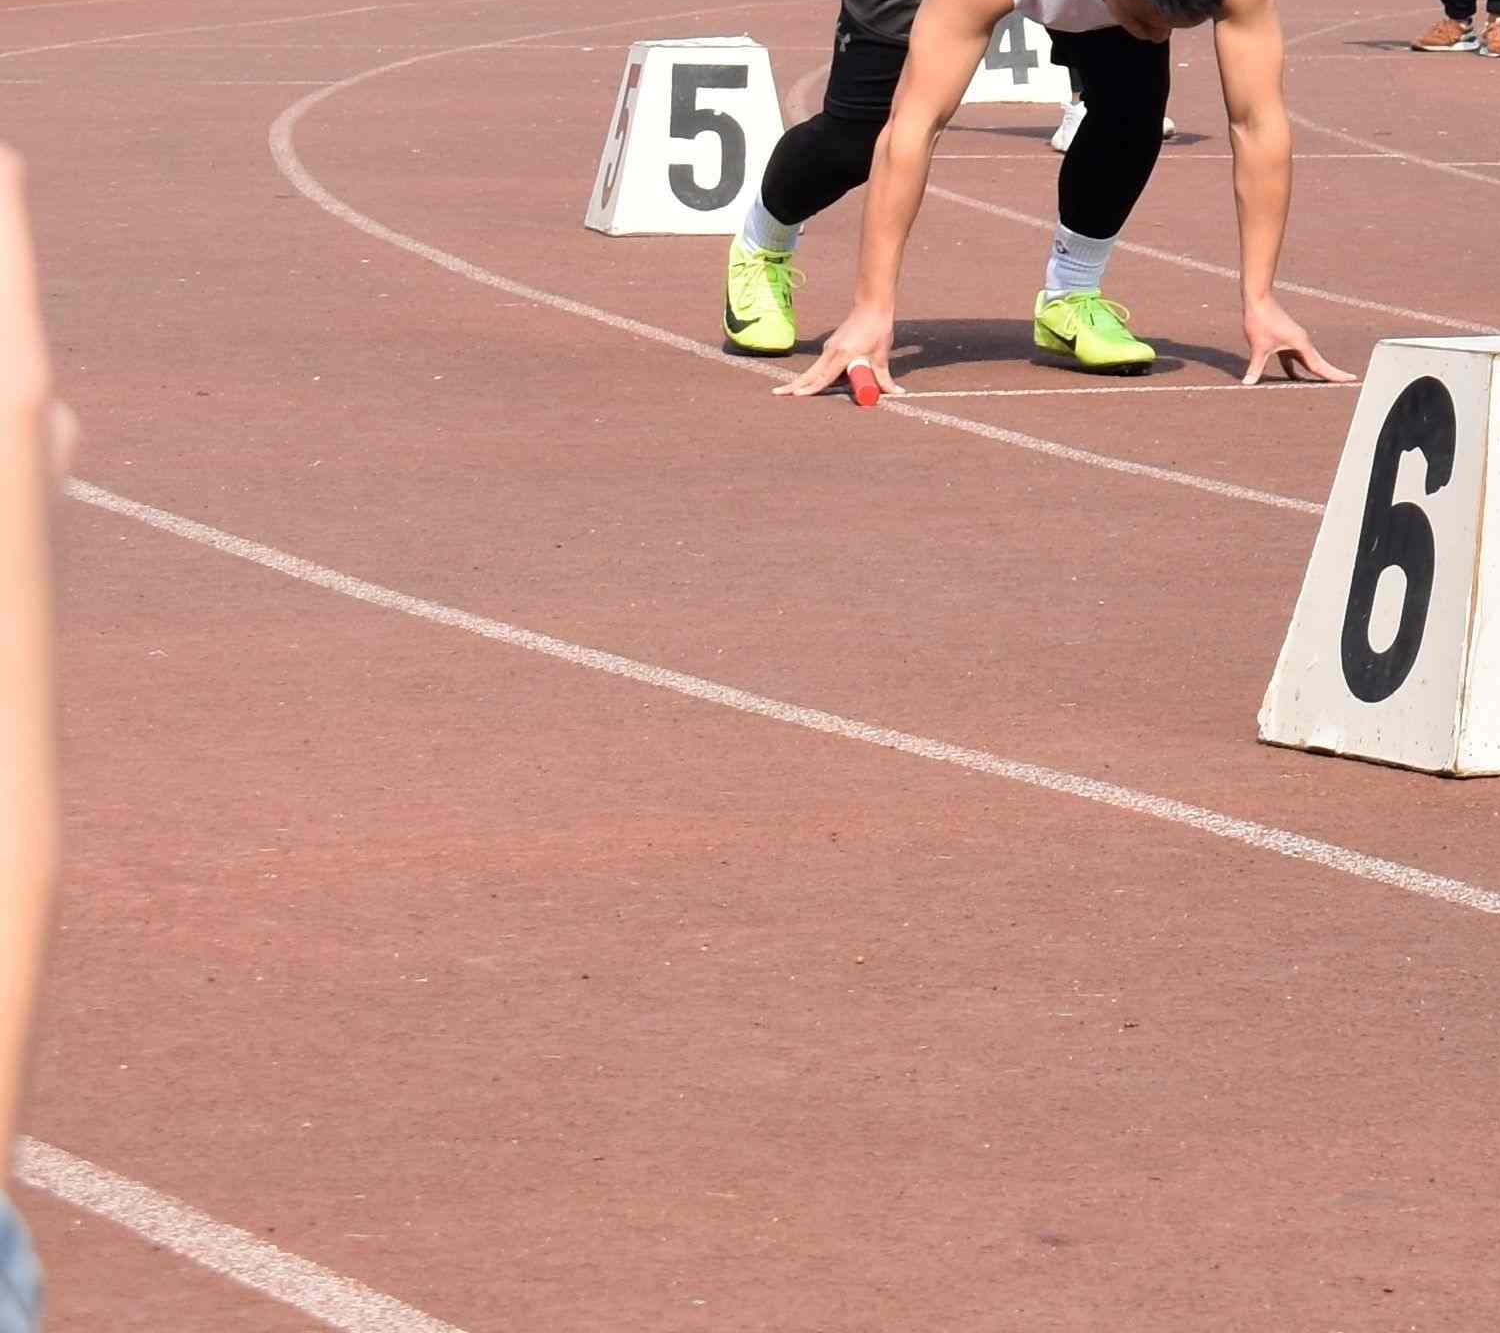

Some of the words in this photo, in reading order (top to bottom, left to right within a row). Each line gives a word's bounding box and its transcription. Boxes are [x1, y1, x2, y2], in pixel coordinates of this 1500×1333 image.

[985, 11, 1039, 85] 4
[668, 63, 749, 212] 5
[1340, 375, 1457, 704] 6
